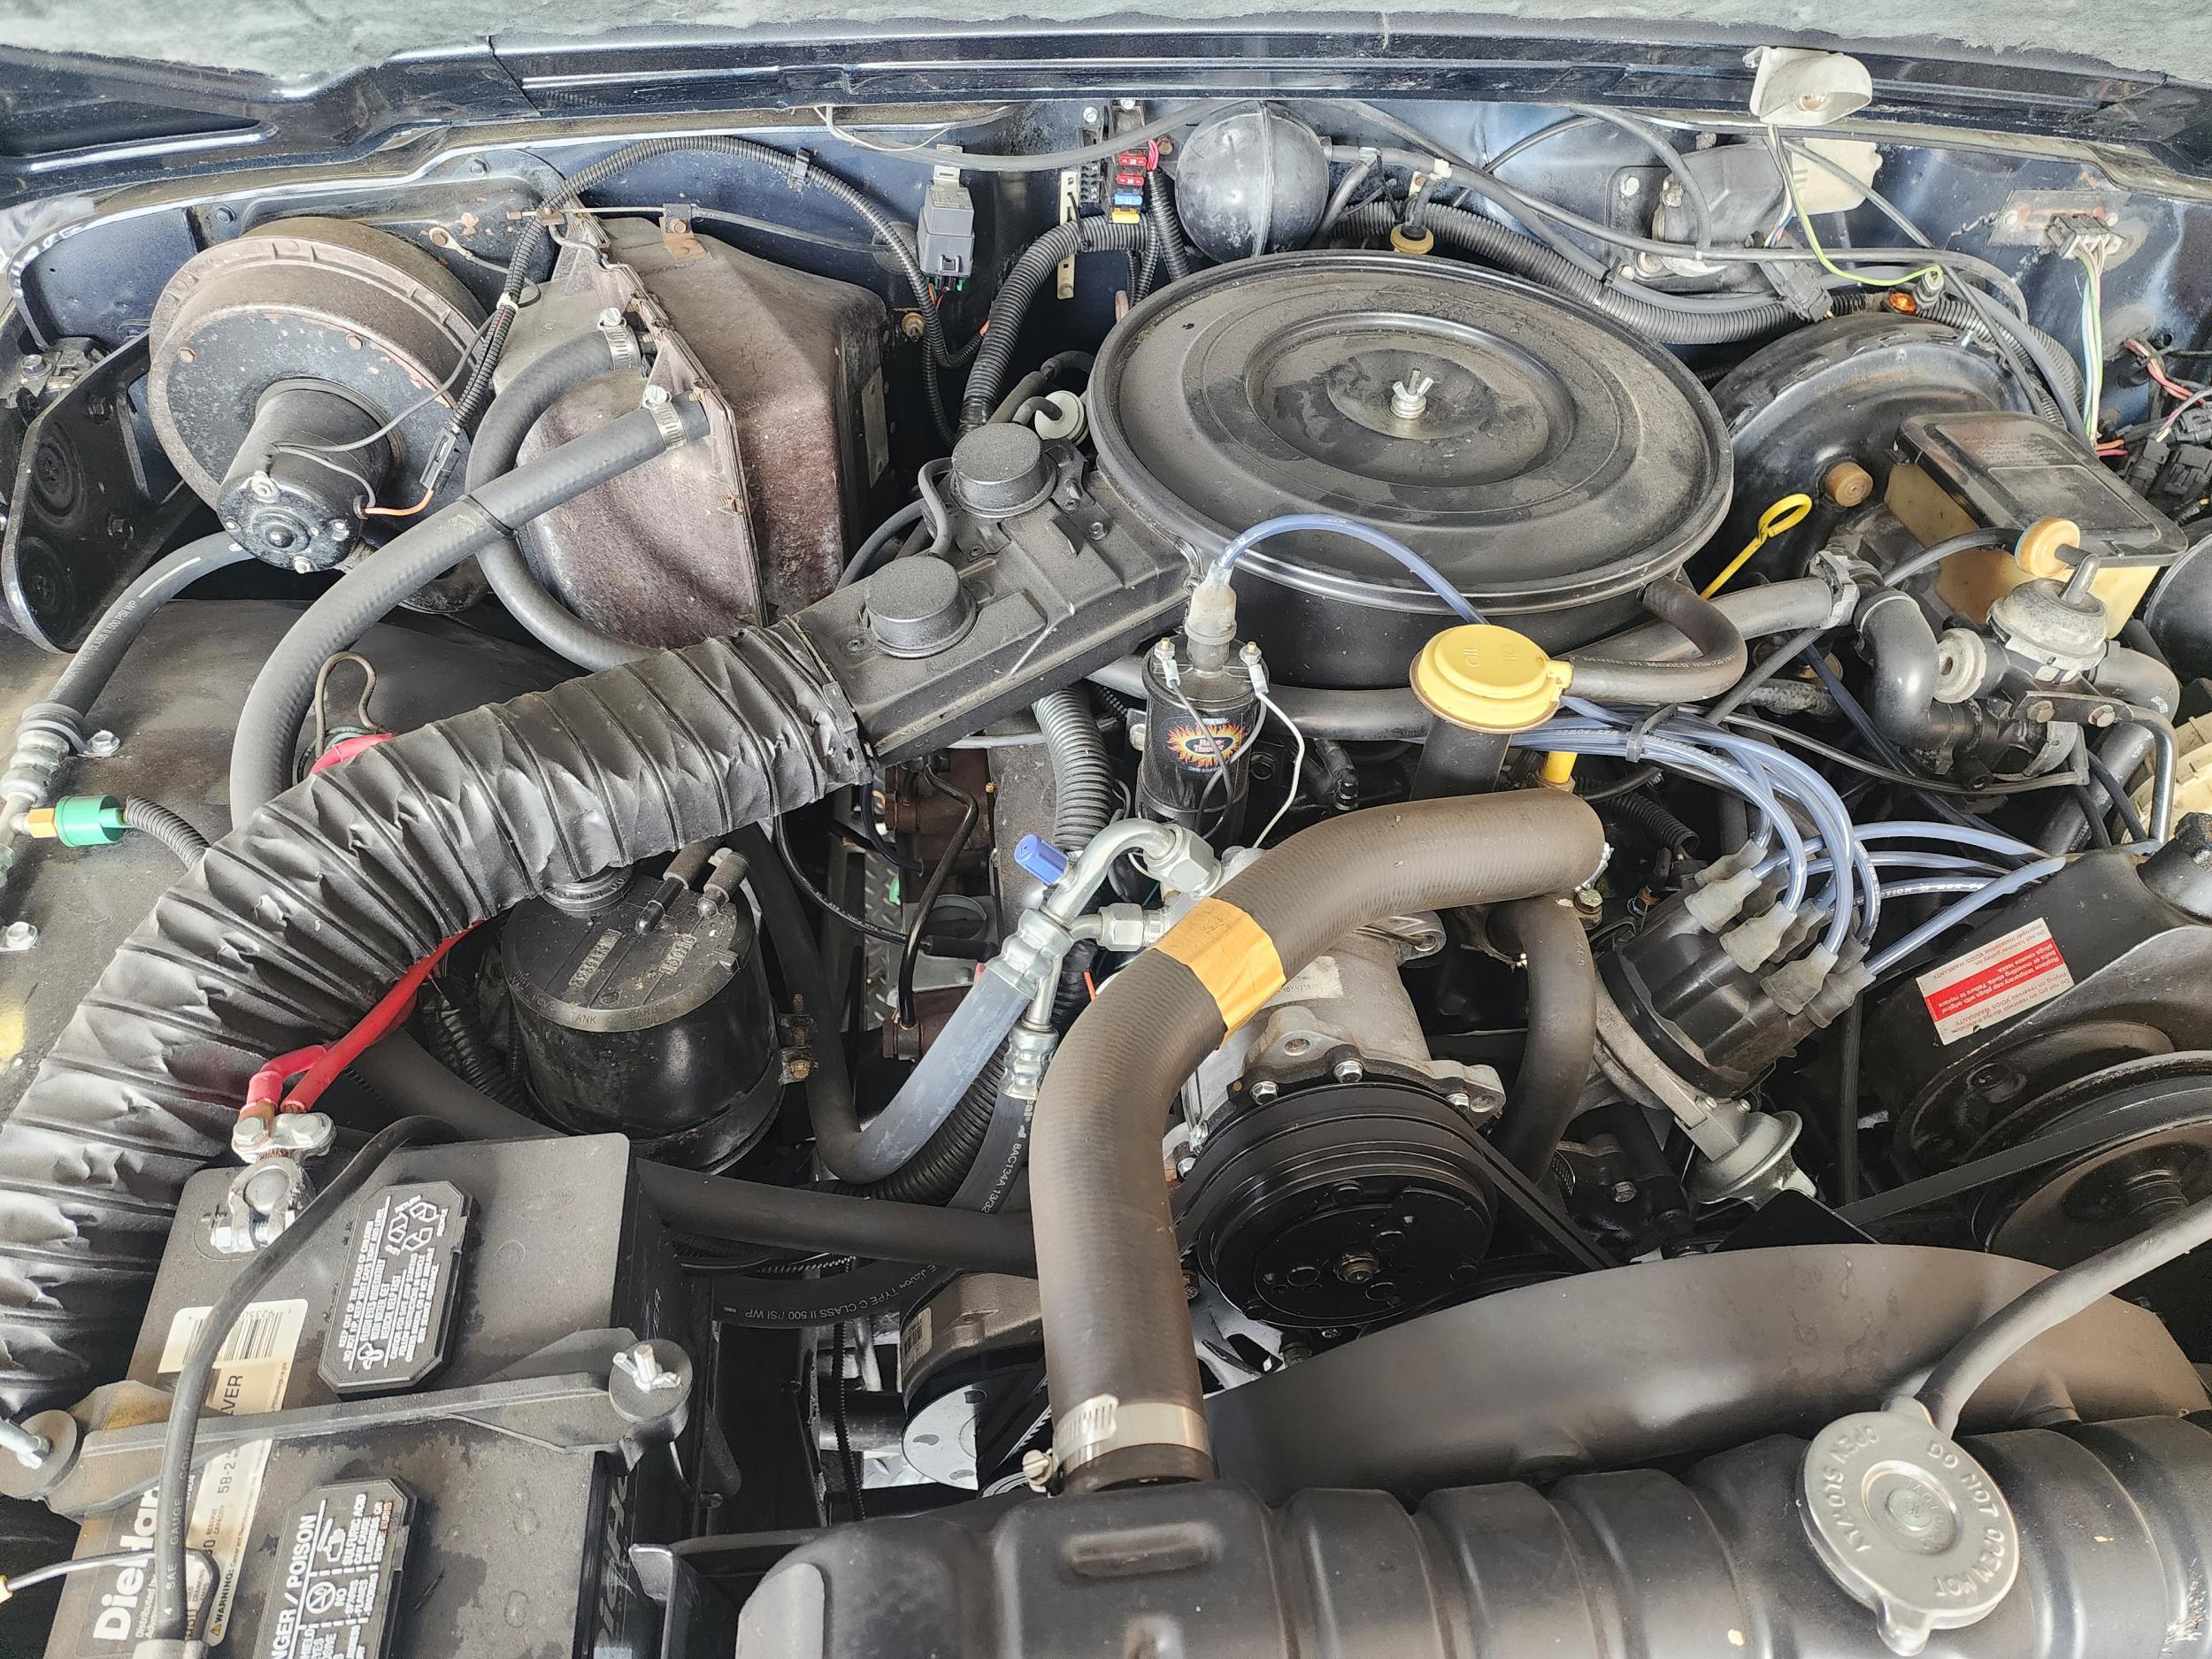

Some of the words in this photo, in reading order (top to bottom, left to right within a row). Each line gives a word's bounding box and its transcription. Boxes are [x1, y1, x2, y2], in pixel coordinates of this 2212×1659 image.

[1583, 655, 1625, 665] Made
[1645, 658, 1689, 671] Mexico
[1193, 741, 1225, 754] Thror
[1199, 737, 1225, 747] Flae
[2014, 923, 2043, 941] Improper
[2024, 933, 2036, 942] not
[1983, 936, 2016, 955] installation
[2001, 938, 2025, 953] hammer
[2034, 942, 2054, 956] plugs
[1964, 951, 1984, 964] VOIDS
[1981, 949, 2001, 962] pulley
[2014, 951, 2036, 965] causes
[2039, 949, 2056, 961] bolts
[2003, 959, 2032, 977] mounting
[2032, 954, 2059, 972] Replace
[1986, 973, 2005, 986] studs.
[2002, 965, 2034, 985] temporary
[2046, 970, 2066, 984] Prying
[2059, 977, 2070, 986] Do
[1965, 981, 1986, 995] Failure
[1991, 979, 2004, 990] cap
[2035, 986, 2047, 995] pry
[2036, 979, 2047, 988] on
[2047, 981, 2060, 991] not
[1974, 985, 1993, 998] plugs
[2007, 984, 2038, 1002] reservoir
[1937, 994, 1960, 1009] replace
[1940, 999, 1963, 1014] original
[1962, 995, 1976, 1004] with
[1991, 997, 2010, 1010] VOIDS
[2001, 995, 2029, 1012] reservoir
[570, 1011, 596, 1024] TANK
[1981, 1007, 2002, 1022] during
[992, 1141, 1025, 1188] 8AC134A
[979, 1186, 1002, 1216] 13/32
[357, 1253, 367, 1263] OF
[868, 1286, 898, 1306] TYPE
[346, 1302, 355, 1311] OF
[818, 1302, 857, 1318] CLASS
[857, 1299, 868, 1309] C
[342, 1314, 352, 1327] OUT
[742, 1306, 765, 1321] WP
[787, 1308, 808, 1322] 500
[345, 1334, 356, 1348] NOT
[353, 1301, 364, 1317] KEEP
[217, 1462, 235, 1493] 58-2
[1925, 1442, 1959, 1469] DO
[1960, 1472, 1999, 1518] NOT
[166, 1498, 187, 1544] GAUGE
[342, 1518, 362, 1564] SULFURIC
[352, 1494, 367, 1516] ACID
[353, 1546, 365, 1563] CAN
[93, 1486, 160, 1641] DieHar
[163, 1564, 180, 1589] SAE
[270, 1609, 297, 1659] NGER
[285, 1515, 318, 1587] POISON
[213, 1569, 234, 1623] WARNING:
[334, 1588, 348, 1605] NO
[134, 1587, 156, 1636] Distributed
[163, 1605, 173, 1615] 4
